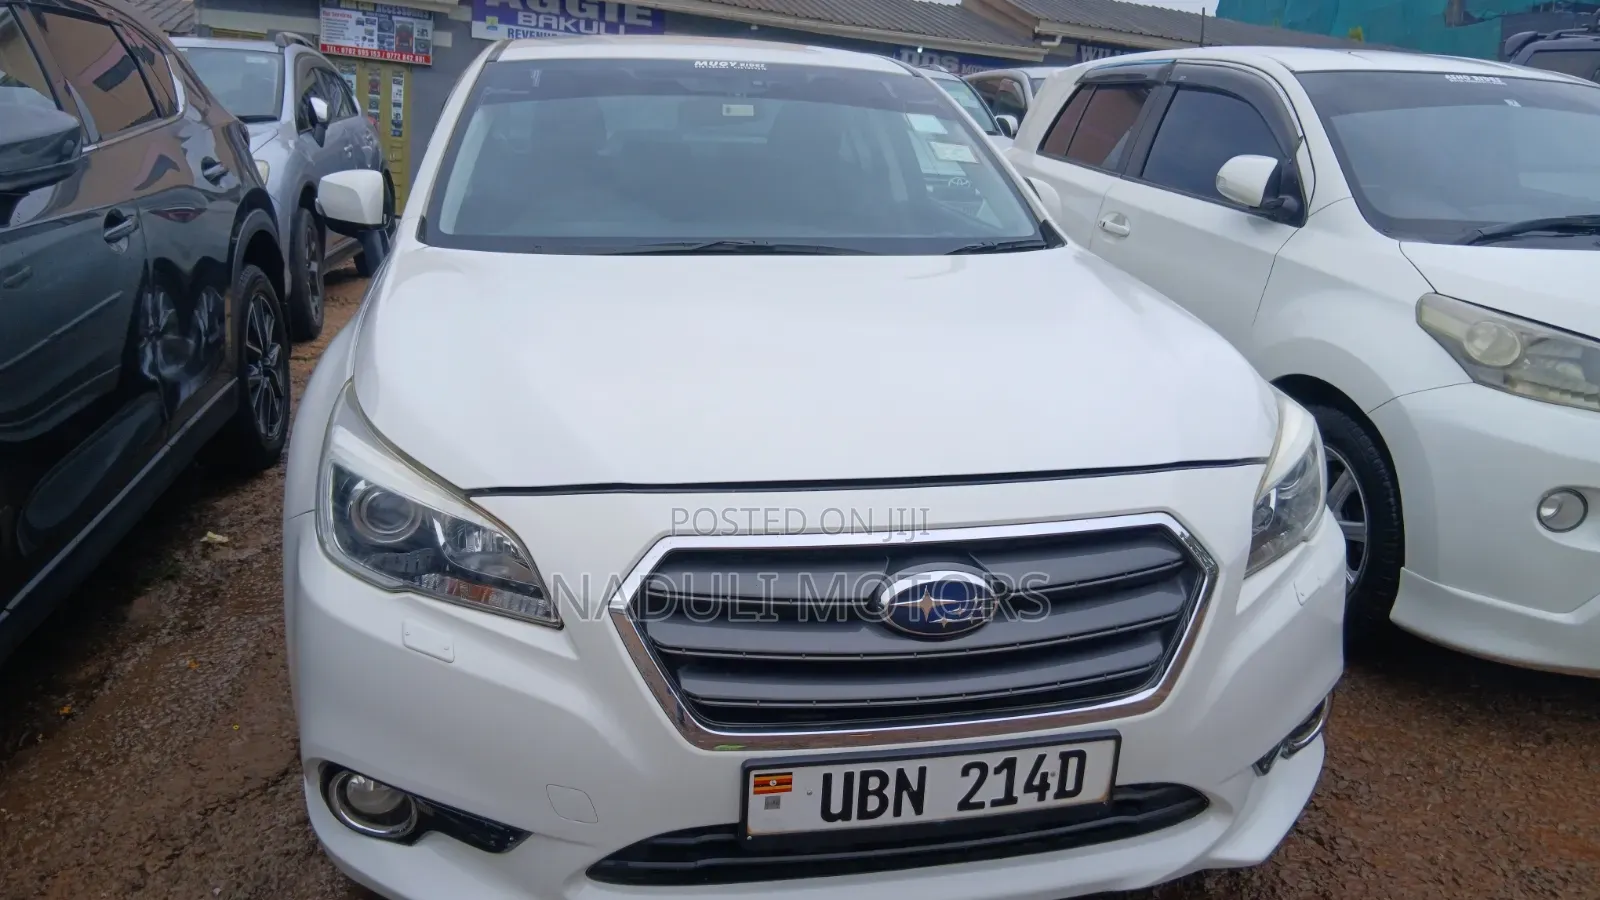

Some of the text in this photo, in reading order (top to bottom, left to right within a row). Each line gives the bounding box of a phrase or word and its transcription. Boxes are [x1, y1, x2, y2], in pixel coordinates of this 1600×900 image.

[507, 27, 558, 39] REVEN
[820, 748, 1087, 823] UBN 214D
